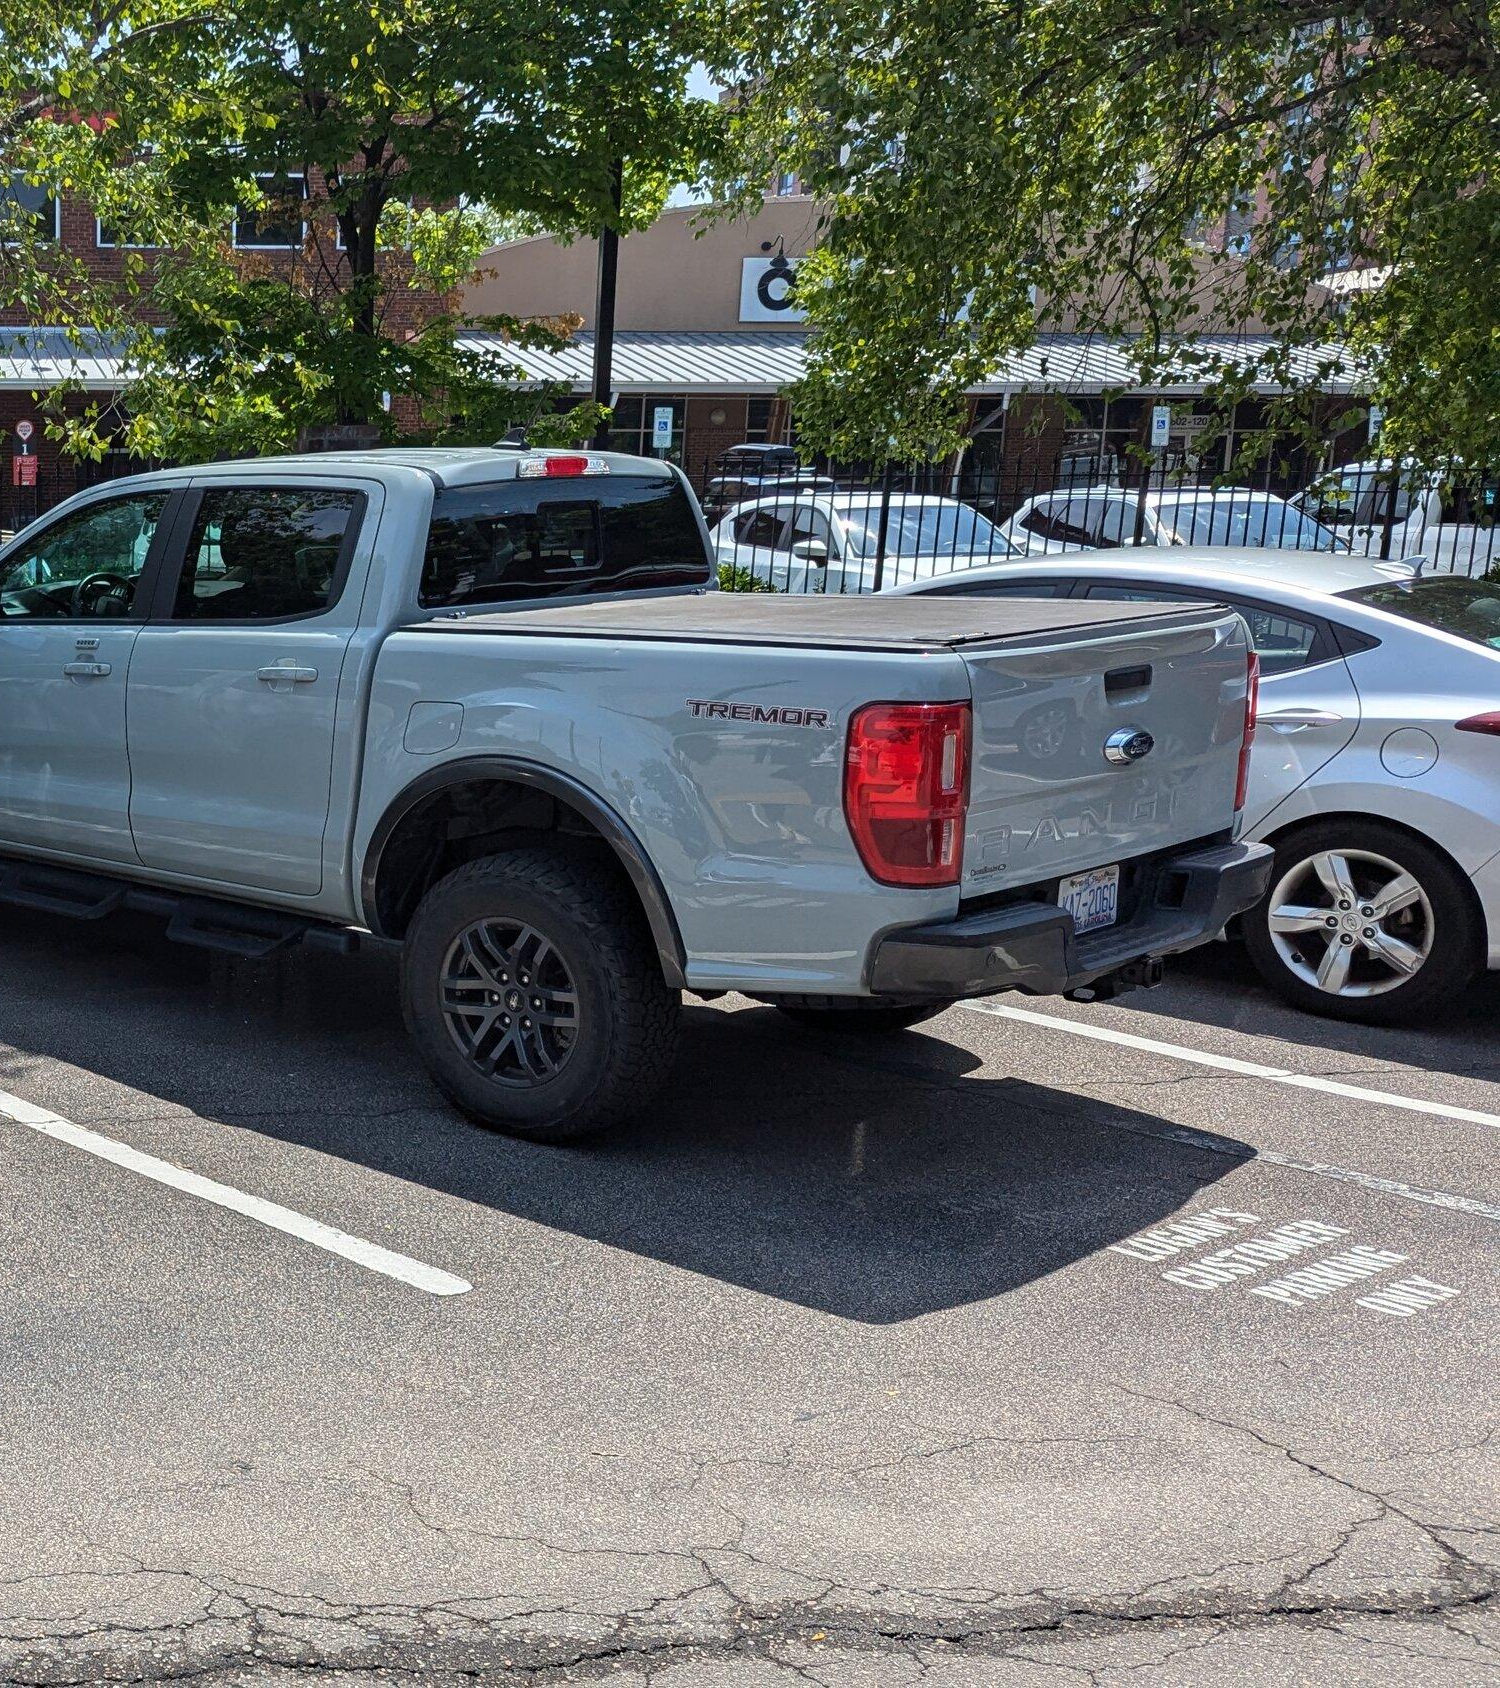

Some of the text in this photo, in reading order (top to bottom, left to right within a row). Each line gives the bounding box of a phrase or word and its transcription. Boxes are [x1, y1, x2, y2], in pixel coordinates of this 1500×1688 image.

[21, 443, 29, 456] 1
[685, 698, 832, 730] TREMOR
[1161, 1219, 1350, 1290] CUSTOMER
[1250, 1245, 1409, 1307] PARKING
[1354, 1274, 1461, 1317] ONLY
